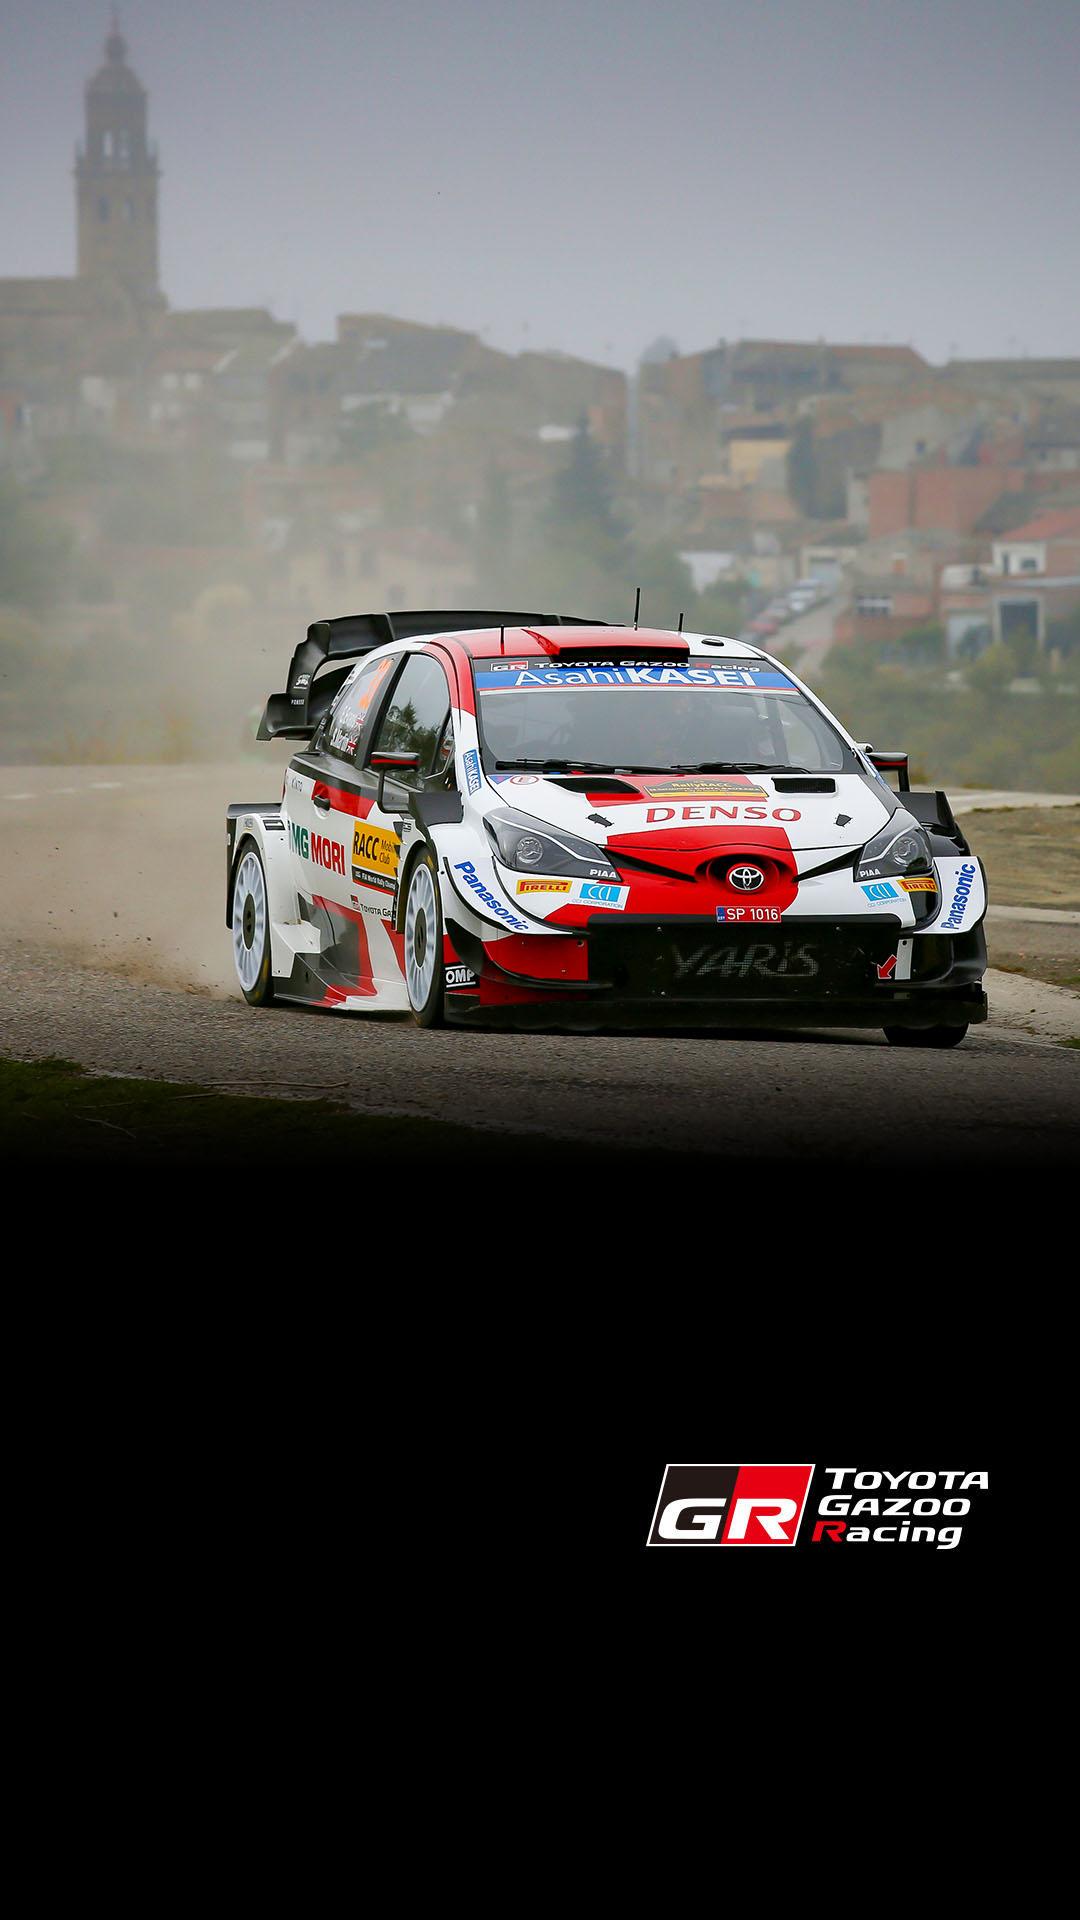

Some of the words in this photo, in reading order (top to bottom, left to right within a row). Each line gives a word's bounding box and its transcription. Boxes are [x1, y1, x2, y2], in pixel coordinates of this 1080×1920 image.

[534, 661, 614, 669] TOYOTA
[620, 660, 690, 668] GAZOO
[694, 662, 760, 672] Racing
[646, 806, 801, 824] DENSO
[287, 820, 309, 859] MG
[310, 831, 346, 876] MORI
[353, 831, 380, 860] RACC
[589, 868, 617, 879] PIAA
[860, 868, 880, 878] PIAA
[519, 881, 569, 892] PIRELLI
[454, 860, 529, 931] Panasonic
[940, 863, 976, 930] Panasonic
[726, 908, 745, 920] SP
[750, 908, 778, 921] 1016
[445, 968, 475, 984] OMP
